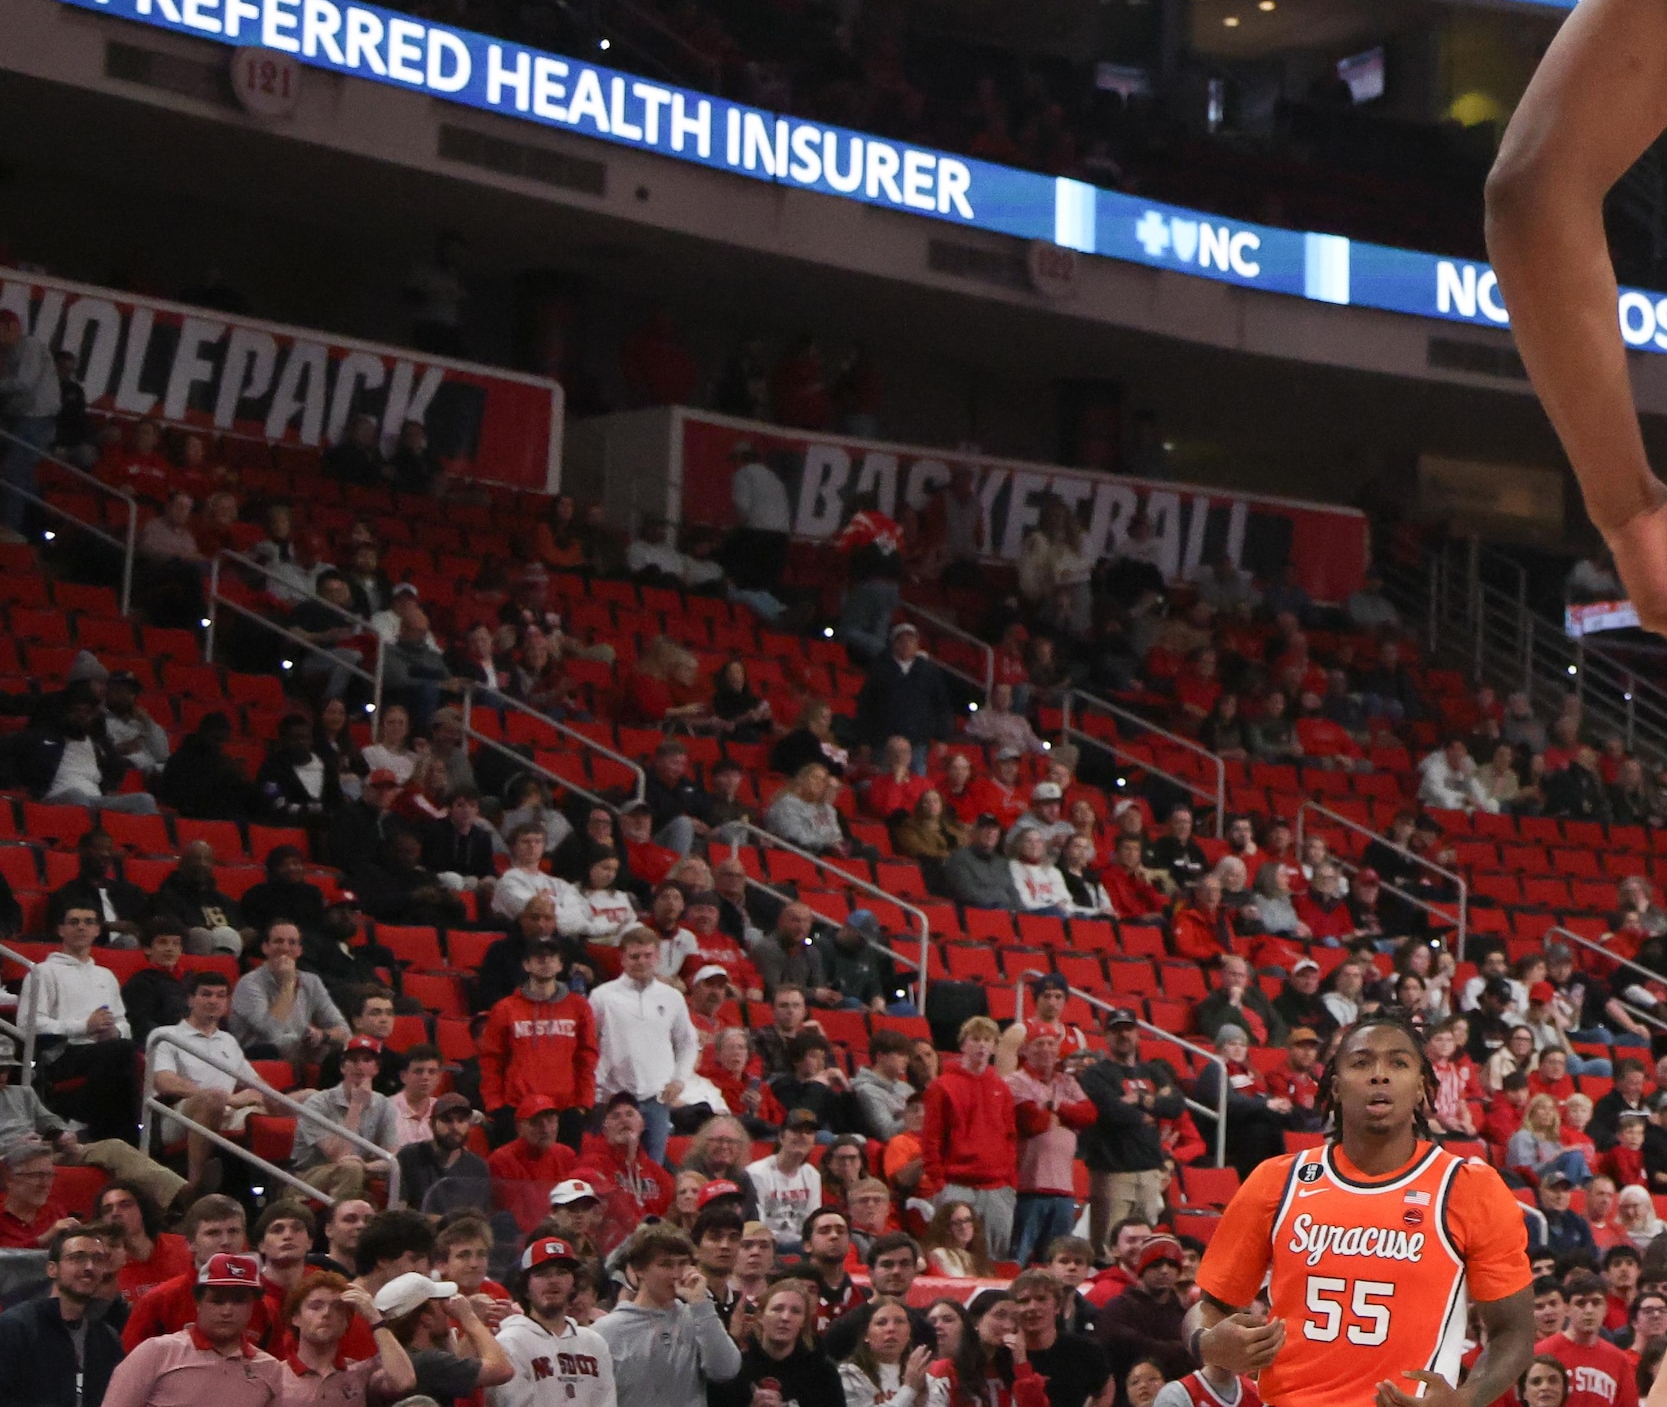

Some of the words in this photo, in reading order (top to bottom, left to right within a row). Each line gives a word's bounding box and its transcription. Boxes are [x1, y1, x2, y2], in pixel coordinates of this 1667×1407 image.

[487, 45, 710, 157] HEALTH
[727, 109, 973, 219] INSURER
[1200, 226, 1260, 277] NC
[1436, 261, 1509, 320] NC
[514, 1020, 531, 1039] NC
[534, 1019, 577, 1038] STATE
[1304, 1170, 1316, 1181] 21
[1290, 1212, 1425, 1267] Syracuse
[1302, 1275, 1396, 1348] 55
